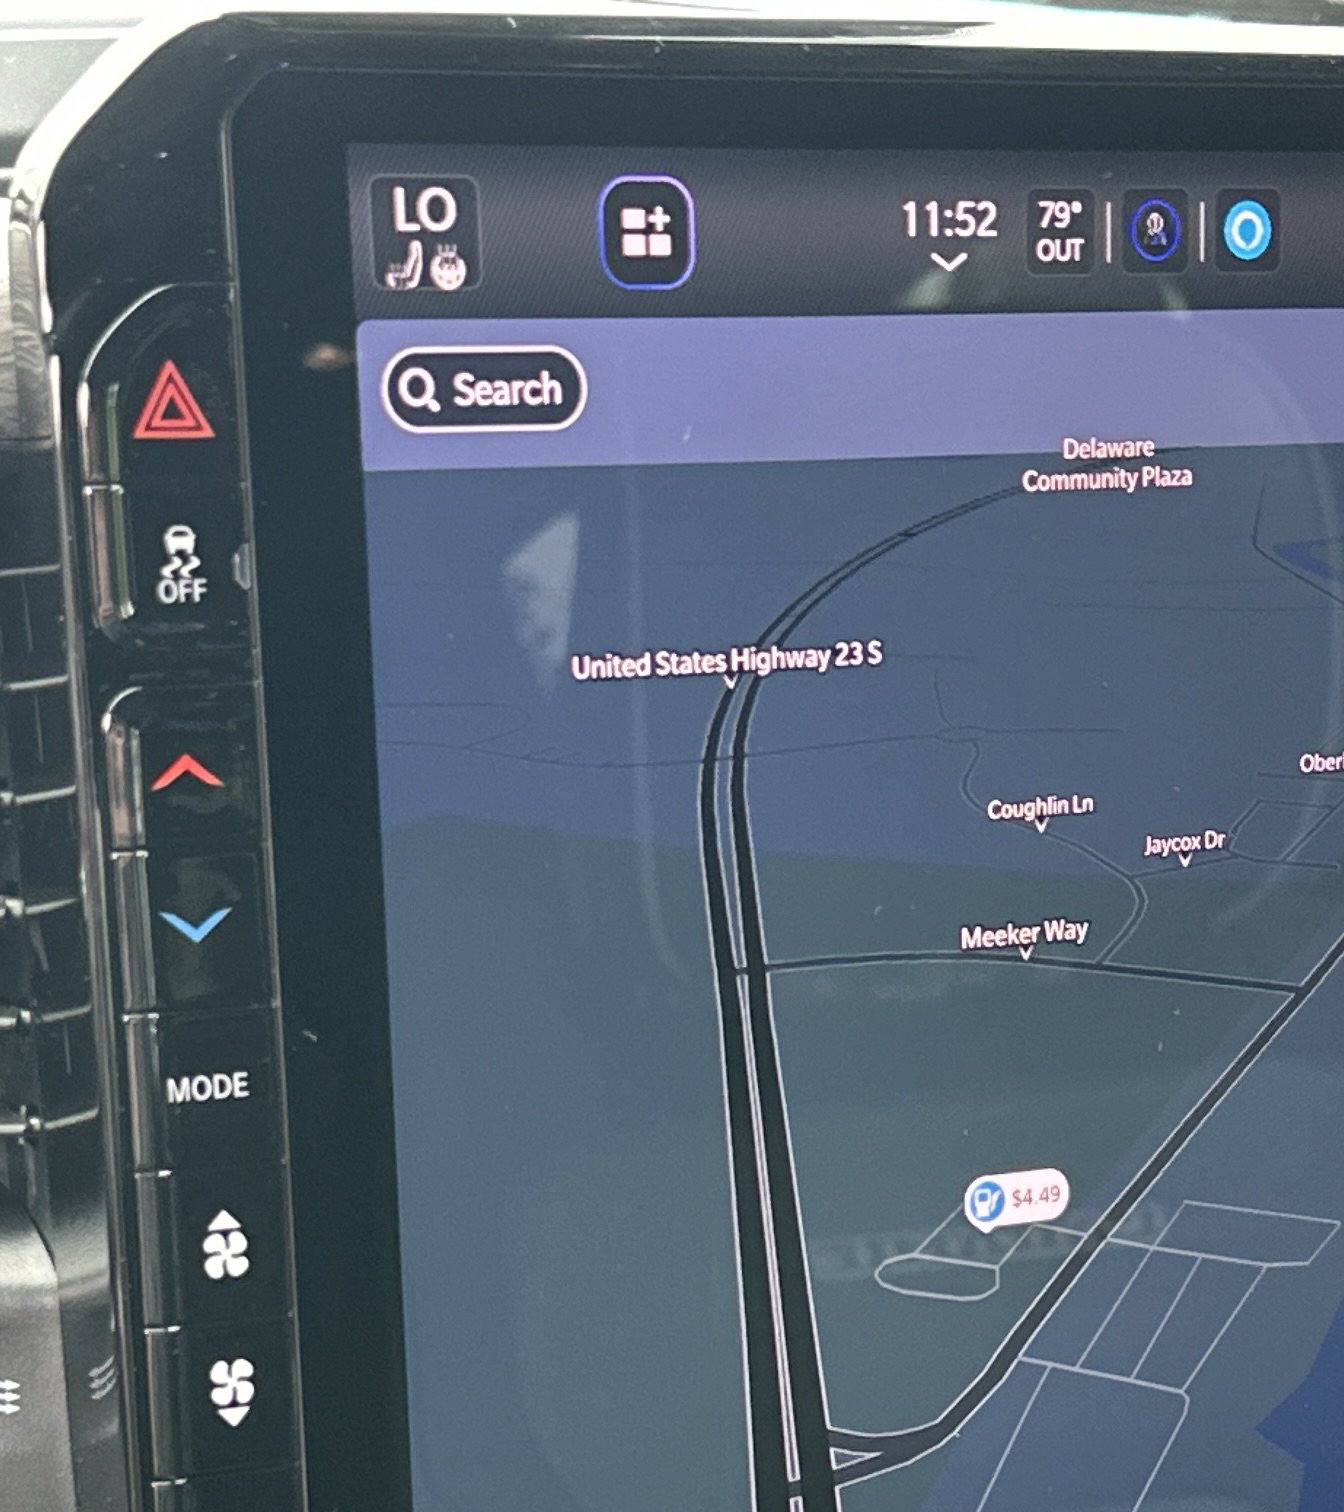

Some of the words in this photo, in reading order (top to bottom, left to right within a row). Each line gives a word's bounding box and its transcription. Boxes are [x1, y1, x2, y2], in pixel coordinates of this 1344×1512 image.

[392, 186, 457, 233] LO
[902, 200, 998, 238] 11:52
[1037, 200, 1083, 230] 79°
[1036, 237, 1085, 264] OUT
[453, 371, 563, 408] Search
[1063, 437, 1155, 460] Delaware
[1022, 466, 1139, 493] Community
[1142, 466, 1193, 488] Plaza
[157, 577, 209, 605] OFF
[571, 652, 651, 680] United
[655, 650, 728, 676] States
[731, 645, 832, 676] Highway
[834, 641, 864, 667] 23
[866, 640, 883, 666] S
[987, 797, 1069, 821] Coughlin
[1072, 795, 1094, 814] Ln
[1144, 836, 1202, 857] Jaycox
[1204, 830, 1226, 850] Dr
[960, 925, 1041, 951] Meeker
[1043, 920, 1090, 946] Way
[166, 1071, 250, 1104] MODE
[1011, 1184, 1061, 1210] $4.49
